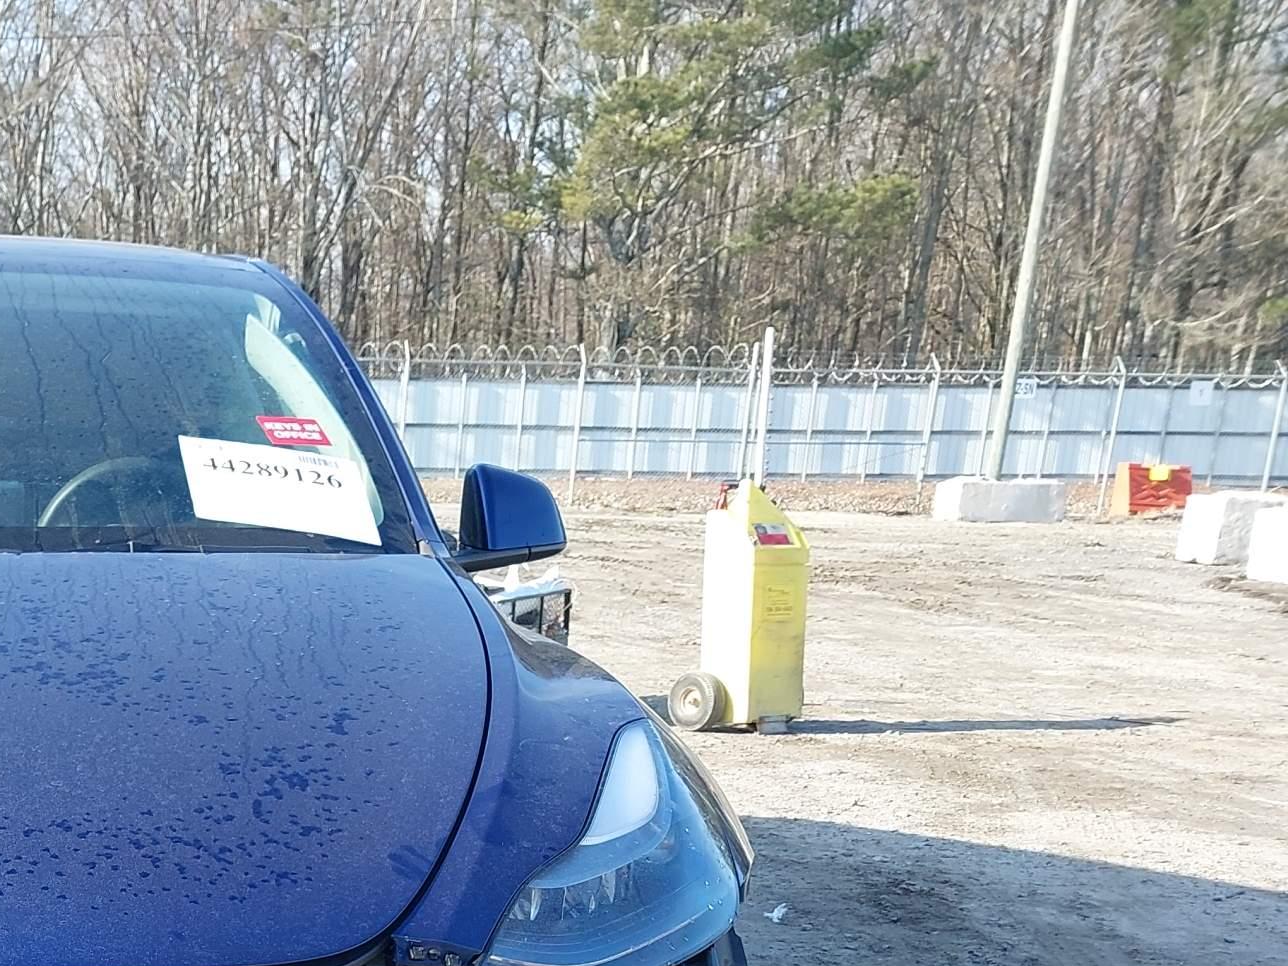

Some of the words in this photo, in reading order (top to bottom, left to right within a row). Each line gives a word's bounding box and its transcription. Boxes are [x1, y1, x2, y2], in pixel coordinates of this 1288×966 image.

[264, 422, 302, 432] KEYS
[303, 423, 321, 433] IN
[274, 431, 323, 441] OFFICE
[203, 457, 342, 488] 44289126
